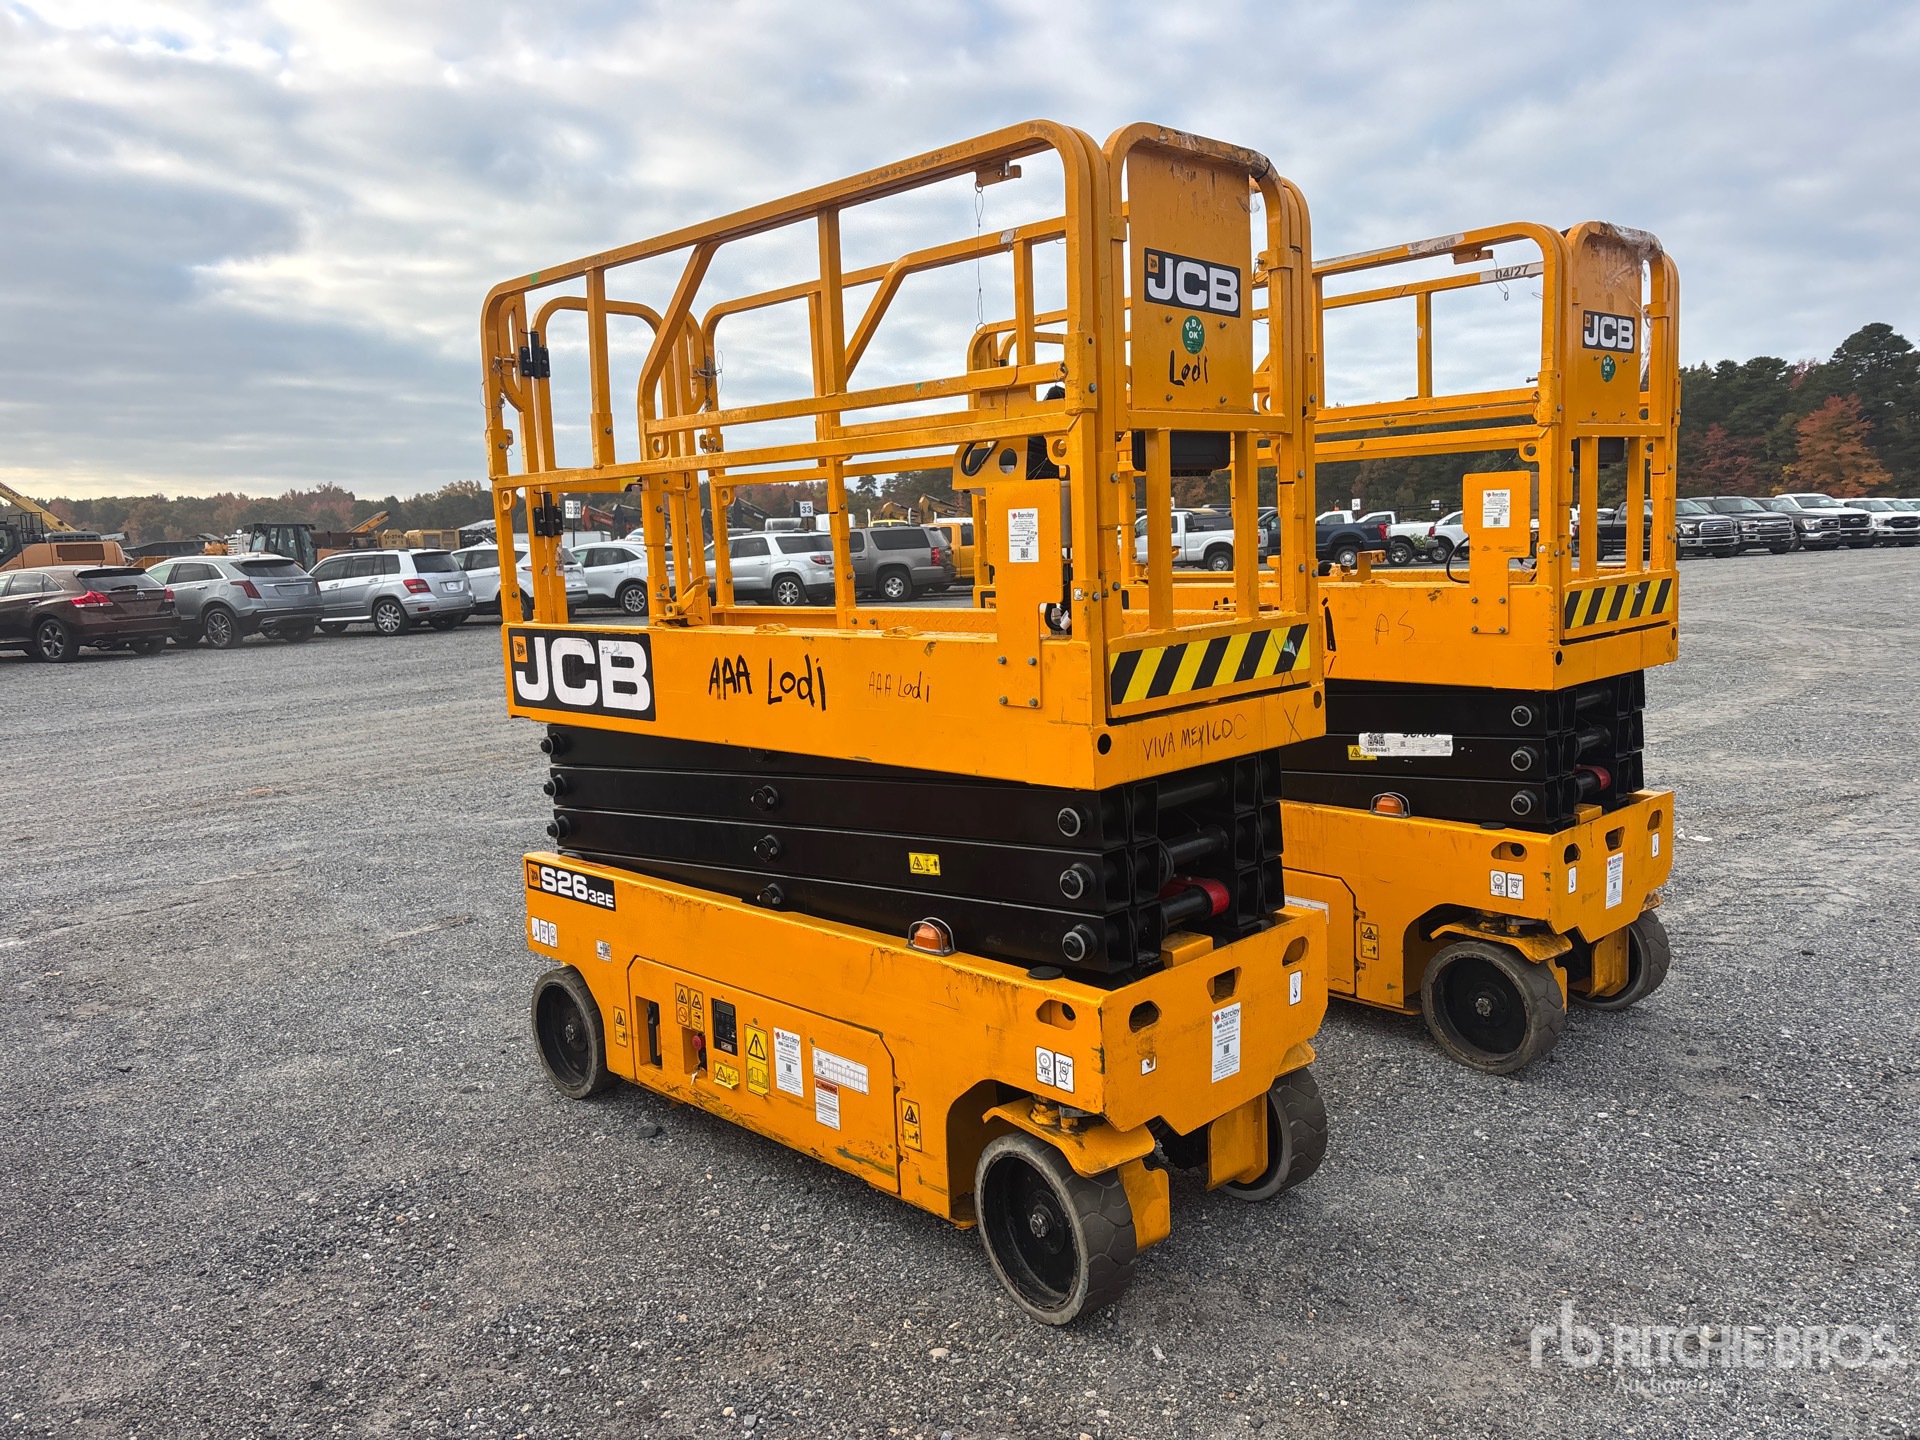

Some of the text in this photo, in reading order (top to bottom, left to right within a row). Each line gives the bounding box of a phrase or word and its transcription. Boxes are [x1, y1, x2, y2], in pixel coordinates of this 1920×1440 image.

[1495, 264, 1529, 279] 04/27
[1147, 257, 1239, 312] JCB
[1188, 331, 1198, 339] OK
[1584, 315, 1634, 350] JCB
[801, 505, 812, 514] 33
[1017, 511, 1034, 519] Barclay
[515, 637, 651, 711] JCB
[708, 654, 827, 712] AAA Lodi
[868, 670, 931, 703] AAA Lodi
[1142, 732, 1176, 761] VIVA
[1220, 1007, 1240, 1019] Barclay
[781, 1032, 800, 1046] Barclay
